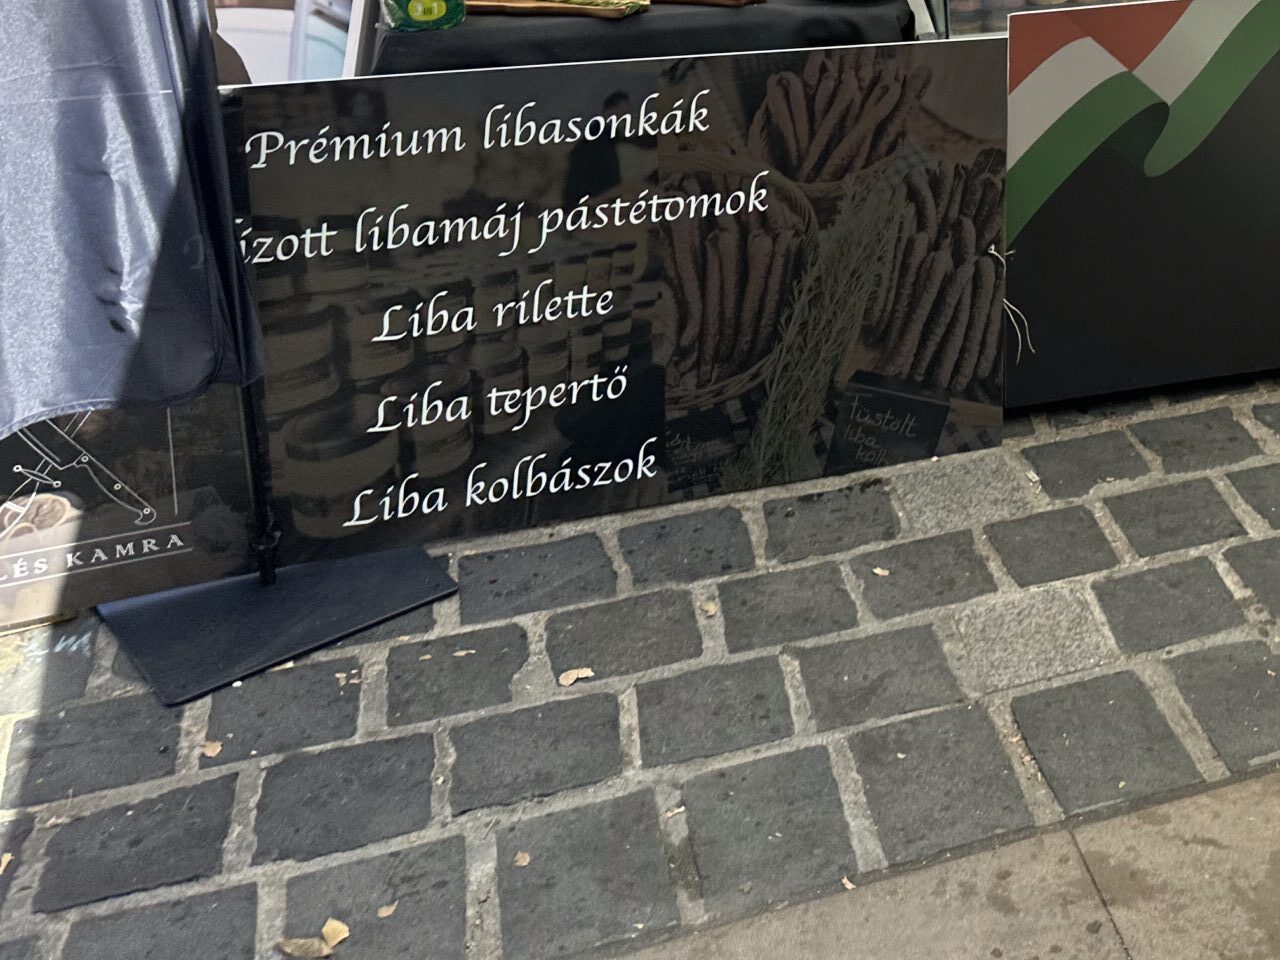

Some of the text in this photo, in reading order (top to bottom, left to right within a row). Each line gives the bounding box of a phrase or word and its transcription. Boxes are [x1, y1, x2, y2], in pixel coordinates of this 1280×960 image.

[244, 89, 711, 169] Prémium libasonkák
[234, 170, 771, 264] ízott libamáj pástétomok
[371, 279, 615, 343] Liba rilette
[366, 363, 629, 434] Liba tepertő
[342, 473, 449, 528] Liba
[464, 437, 659, 508] kolbászok
[65, 533, 185, 569] KAMRA
